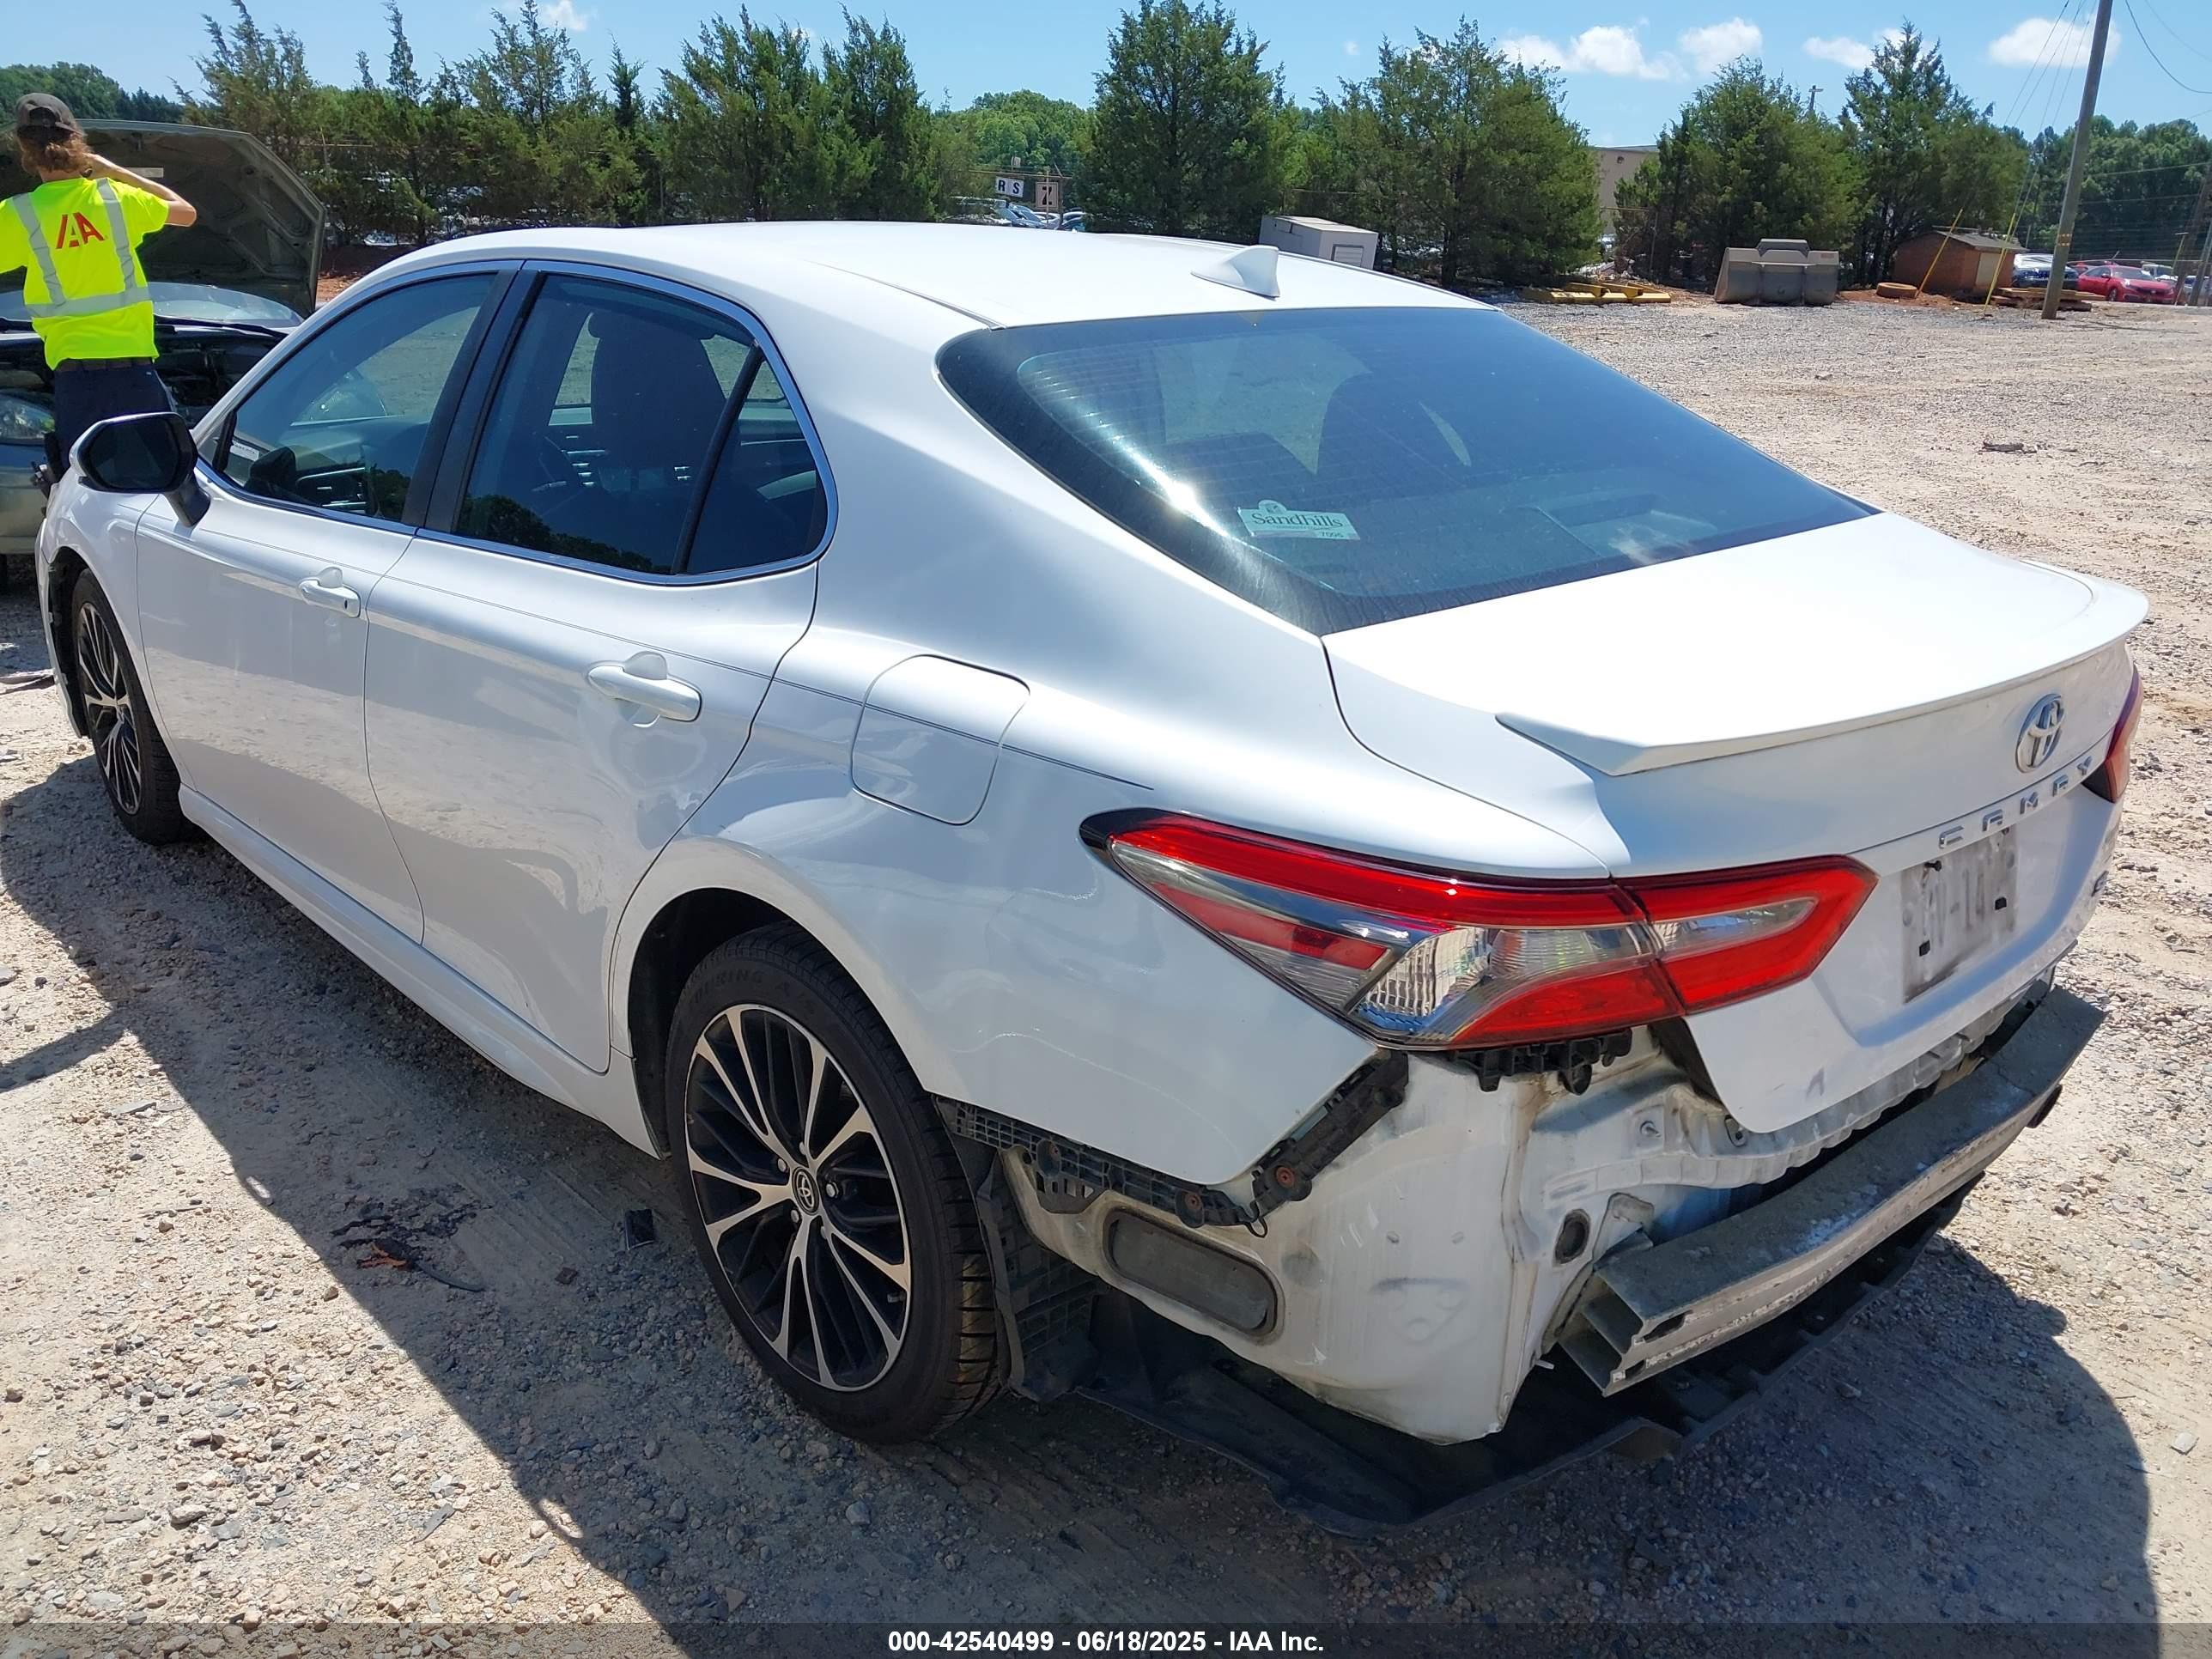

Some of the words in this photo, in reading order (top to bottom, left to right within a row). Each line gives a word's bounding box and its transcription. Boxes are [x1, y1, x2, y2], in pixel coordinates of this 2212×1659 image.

[998, 179, 1006, 192] R
[1012, 182, 1021, 195] S
[1251, 513, 1344, 528] Sandhills
[1938, 755, 2094, 850] CAMRY
